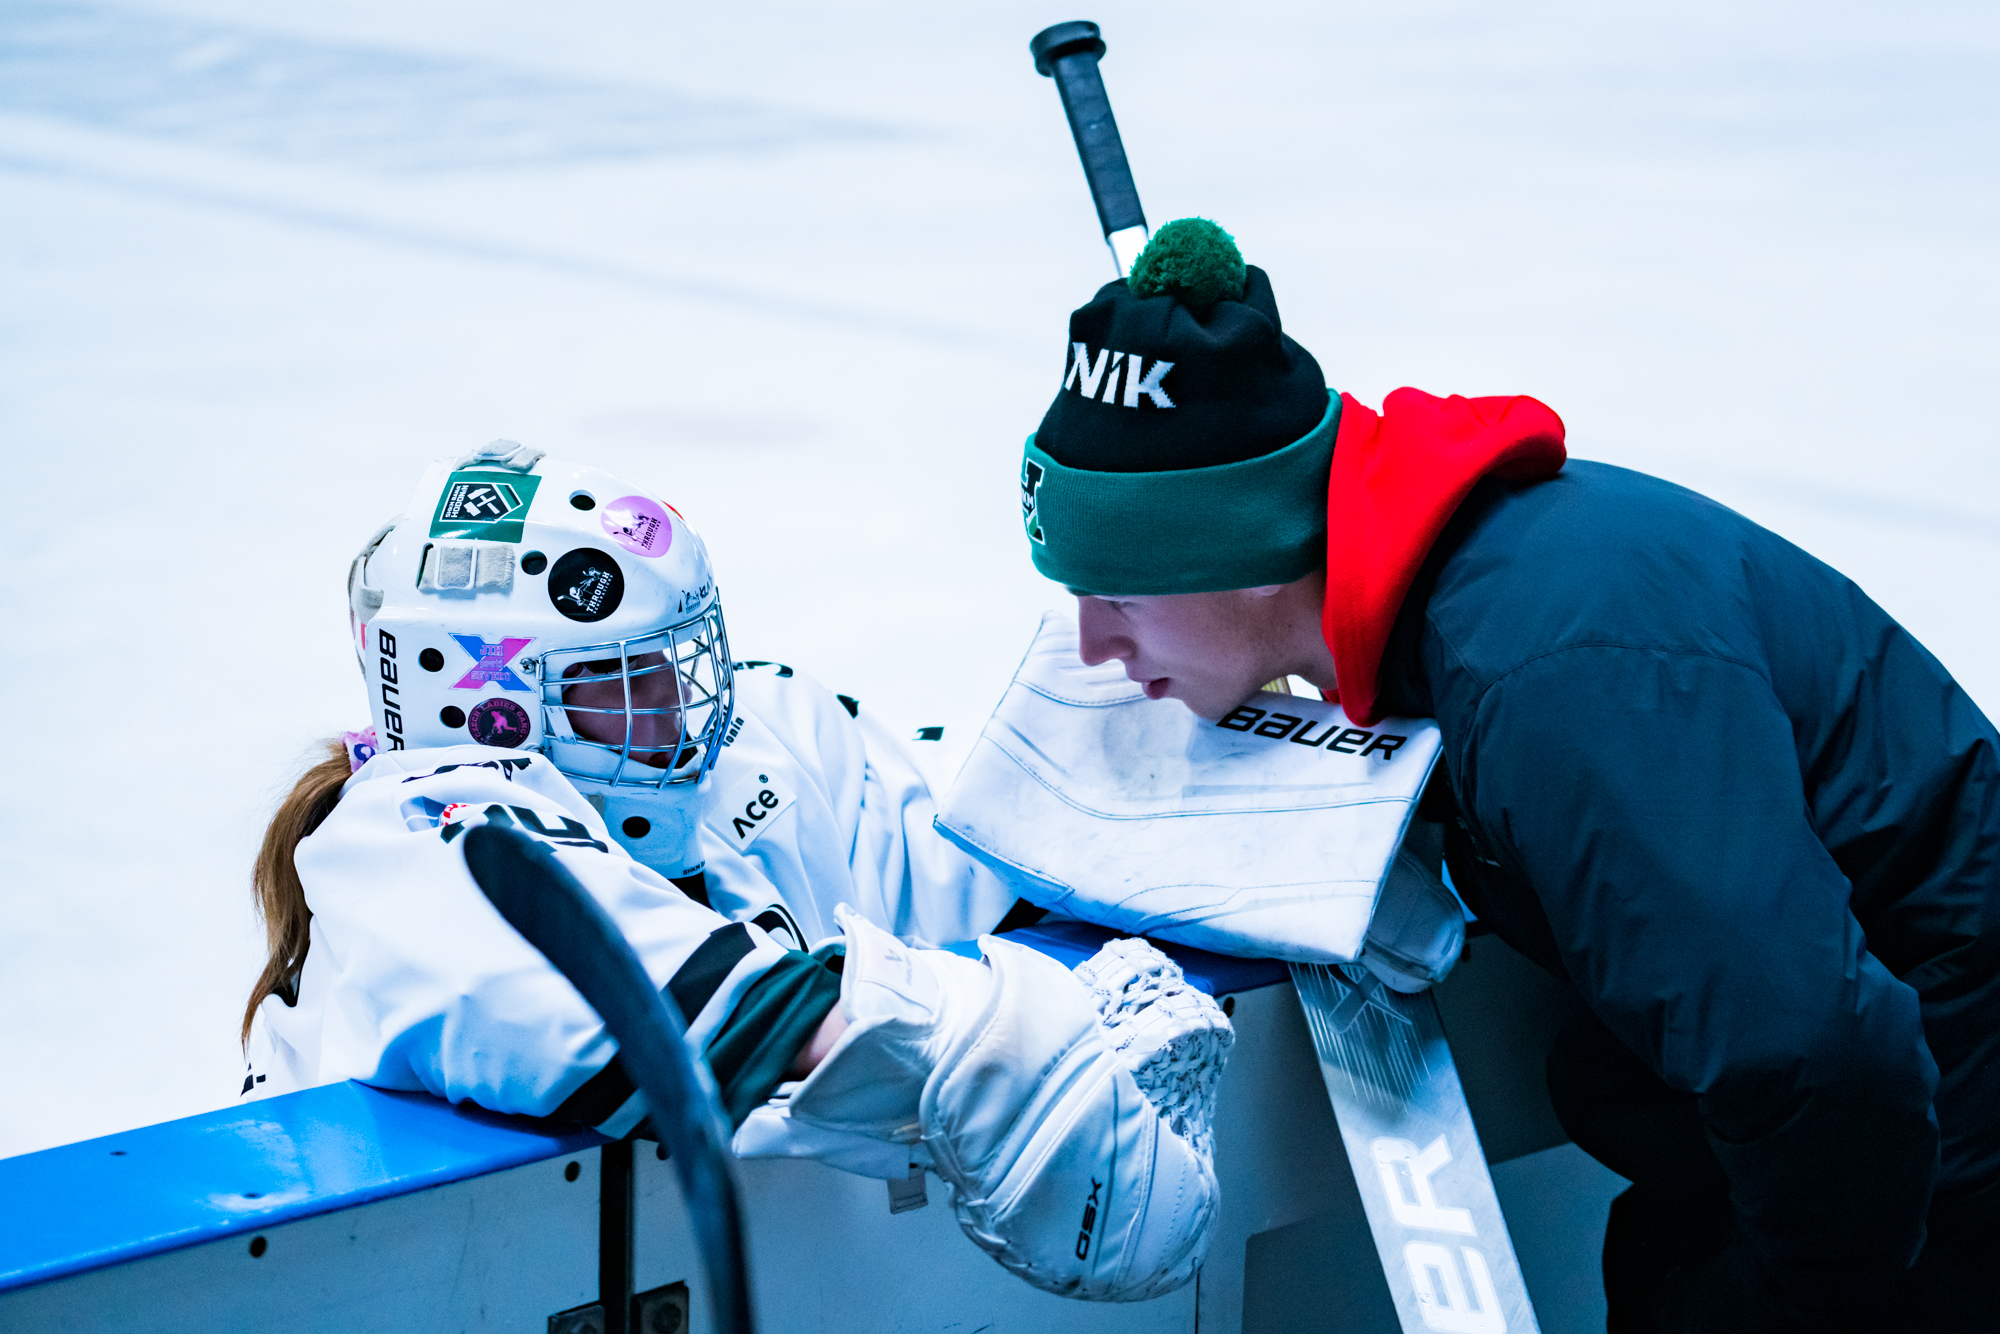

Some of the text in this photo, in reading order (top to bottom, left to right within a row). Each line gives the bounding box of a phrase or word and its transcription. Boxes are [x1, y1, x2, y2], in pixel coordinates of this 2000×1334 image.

[641, 517, 658, 548] THROUGH
[586, 571, 610, 612] THROUGH
[480, 644, 504, 656] JIH
[471, 700, 528, 738] CZECH LADIES GANG
[1075, 1176, 1102, 1261] GSX
